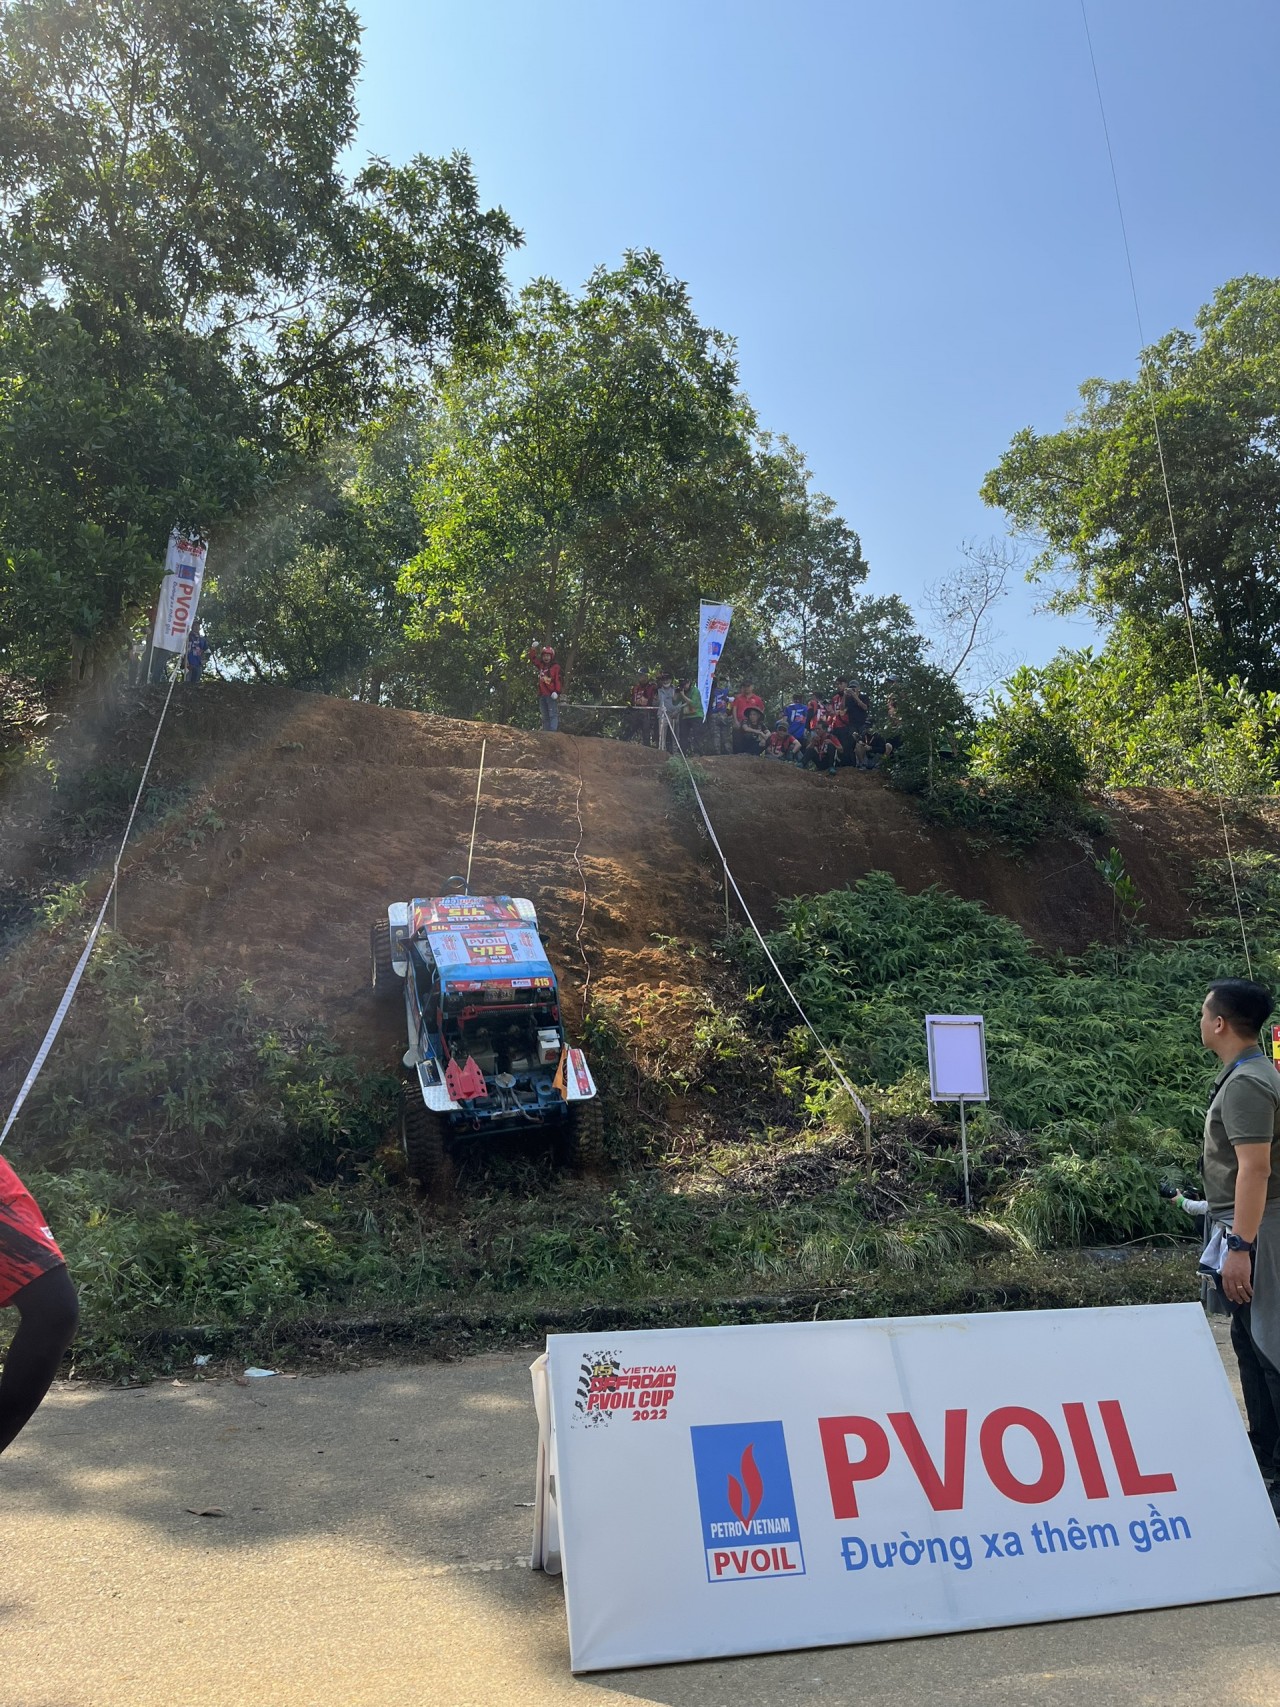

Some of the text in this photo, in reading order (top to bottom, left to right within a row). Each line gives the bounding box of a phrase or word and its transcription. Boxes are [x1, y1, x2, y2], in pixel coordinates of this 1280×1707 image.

[171, 583, 194, 637] PVOIL
[472, 946, 507, 956] 415
[534, 978, 550, 987] 415
[622, 1365, 677, 1374] VIETNAM
[590, 1373, 677, 1392] OFFROAD
[587, 1390, 674, 1410] PVOIL CUP
[632, 1409, 668, 1421] 2022
[818, 1400, 1177, 1519] PVOIL
[710, 1517, 791, 1539] PETROVIETNAM
[841, 1503, 1192, 1571] Đường xa thêm gần
[714, 1547, 796, 1576] PVOIL
